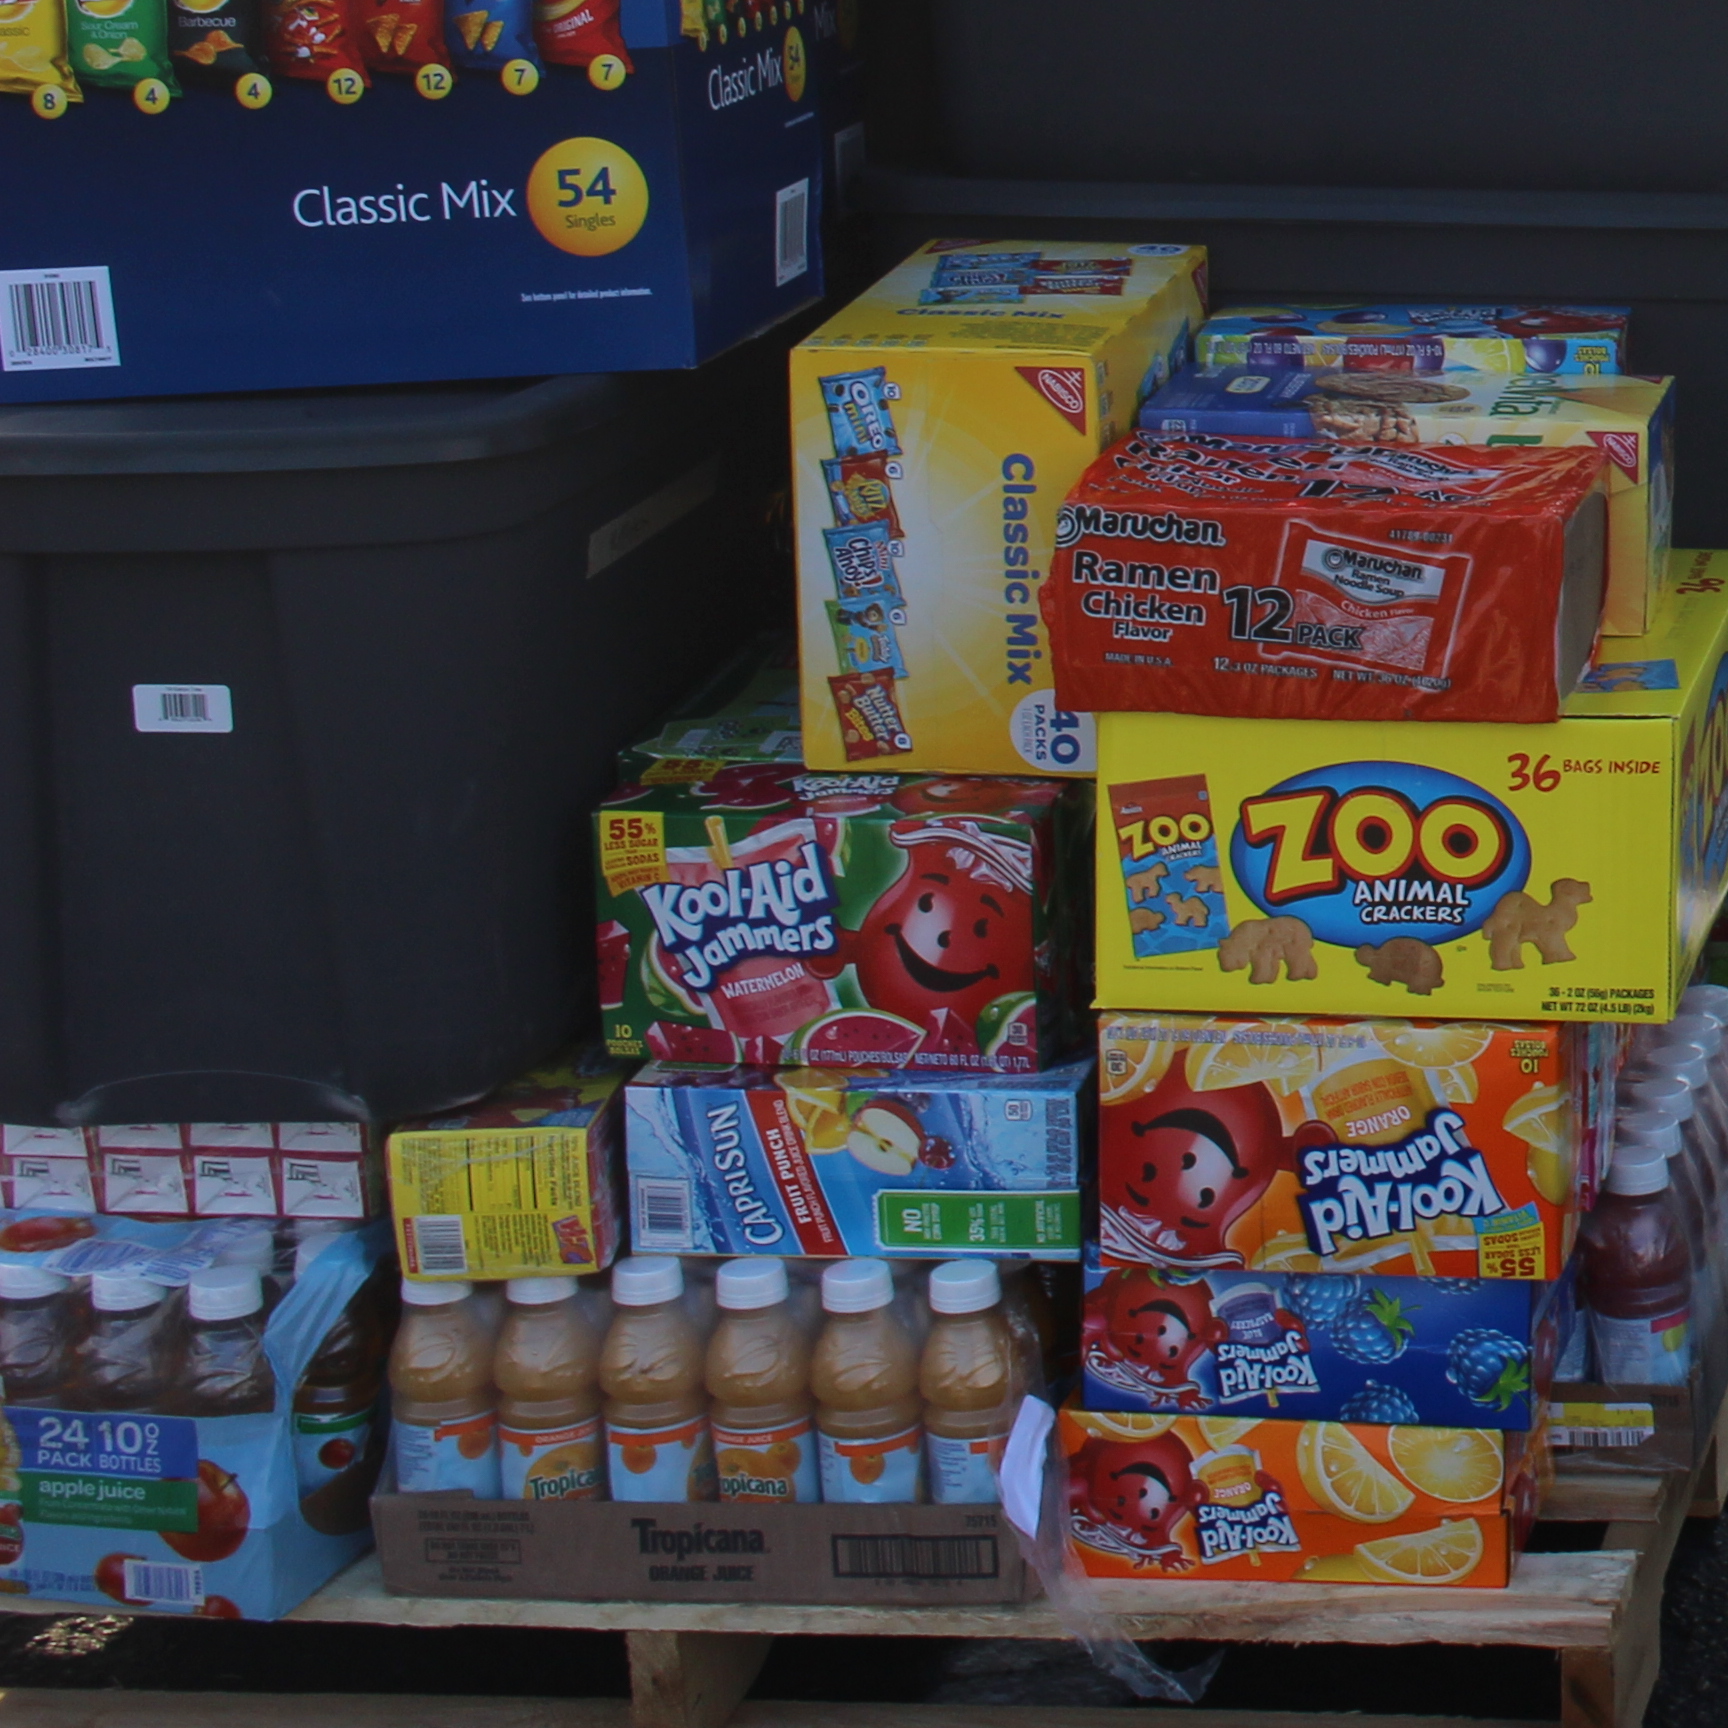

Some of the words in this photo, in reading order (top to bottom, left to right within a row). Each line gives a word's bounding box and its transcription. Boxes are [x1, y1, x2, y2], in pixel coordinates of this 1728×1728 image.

[177, 15, 236, 29] Barbecue
[553, 12, 595, 32] ORIGINAL
[334, 77, 357, 97] 12
[422, 72, 446, 92] 12
[514, 68, 527, 87] 7
[601, 63, 614, 82] 7
[708, 56, 756, 111] Classic
[757, 47, 783, 89] Mix
[145, 86, 158, 107] 4
[247, 82, 261, 103] 4
[293, 186, 431, 229] Classic
[440, 178, 517, 222] Mix
[556, 166, 617, 207] 54
[564, 211, 617, 232] Singles
[1042, 371, 1082, 411] NABISCO
[843, 402, 868, 444] mini
[849, 383, 885, 451] OREO
[1001, 453, 1035, 600] Classic
[1076, 505, 1222, 546] Maruchan
[851, 538, 878, 578] Chips
[1072, 550, 1219, 595] Ramen
[1343, 548, 1423, 580] Maruchan
[1333, 573, 1371, 592] Noodle
[1373, 582, 1404, 598] Soup
[1082, 590, 1206, 626] Chicken
[1224, 585, 1294, 641] 12
[1297, 624, 1364, 650] PACK
[1005, 611, 1033, 685] Mix
[1112, 620, 1171, 643] Flavor
[846, 708, 874, 741] Bites
[855, 696, 887, 743] Butter
[868, 684, 902, 733] Nutter
[1033, 704, 1048, 761] PACKS
[1506, 752, 1562, 795] 36
[1563, 757, 1603, 775] BAGS
[1608, 759, 1661, 776] INSIDE
[604, 838, 626, 851] LESS
[628, 837, 659, 850] SUGAR
[609, 818, 641, 839] 55
[1117, 812, 1211, 859] ZOO
[1240, 787, 1513, 903] ZOO
[625, 852, 660, 866] SODAS
[642, 842, 829, 947] Kool-Aid
[1353, 878, 1470, 907] ANIMAL
[1360, 903, 1465, 926] CRACKERS
[682, 915, 834, 985] Jammers
[721, 962, 805, 1000] WATERMELON
[1541, 1002, 1558, 1012] NET
[1560, 1002, 1573, 1012] WT
[1576, 1002, 1586, 1012] 72
[1588, 1002, 1598, 1013] OZ
[1346, 1104, 1410, 1137] ORANGE
[766, 1127, 795, 1179] PUNCH
[1304, 1112, 1464, 1187] Jammers
[787, 1182, 812, 1224] FRUIT
[1307, 1152, 1502, 1254] Kool-Aid
[1218, 1332, 1302, 1362] Jammers
[1219, 1353, 1318, 1395] Kool-Aid
[38, 1417, 89, 1451] 24
[99, 1421, 141, 1454] 10
[37, 1450, 92, 1469] PACK
[99, 1453, 162, 1474] BOTTLES
[38, 1479, 95, 1502] apple
[97, 1481, 146, 1503] juice
[1199, 1492, 1282, 1524] Jammers
[1214, 1482, 1252, 1500] ORANGE
[631, 1518, 765, 1561] Tropicana
[1200, 1515, 1298, 1556] Kool-Aid
[648, 1564, 708, 1583] ORANGE
[712, 1564, 754, 1582] JUICE
